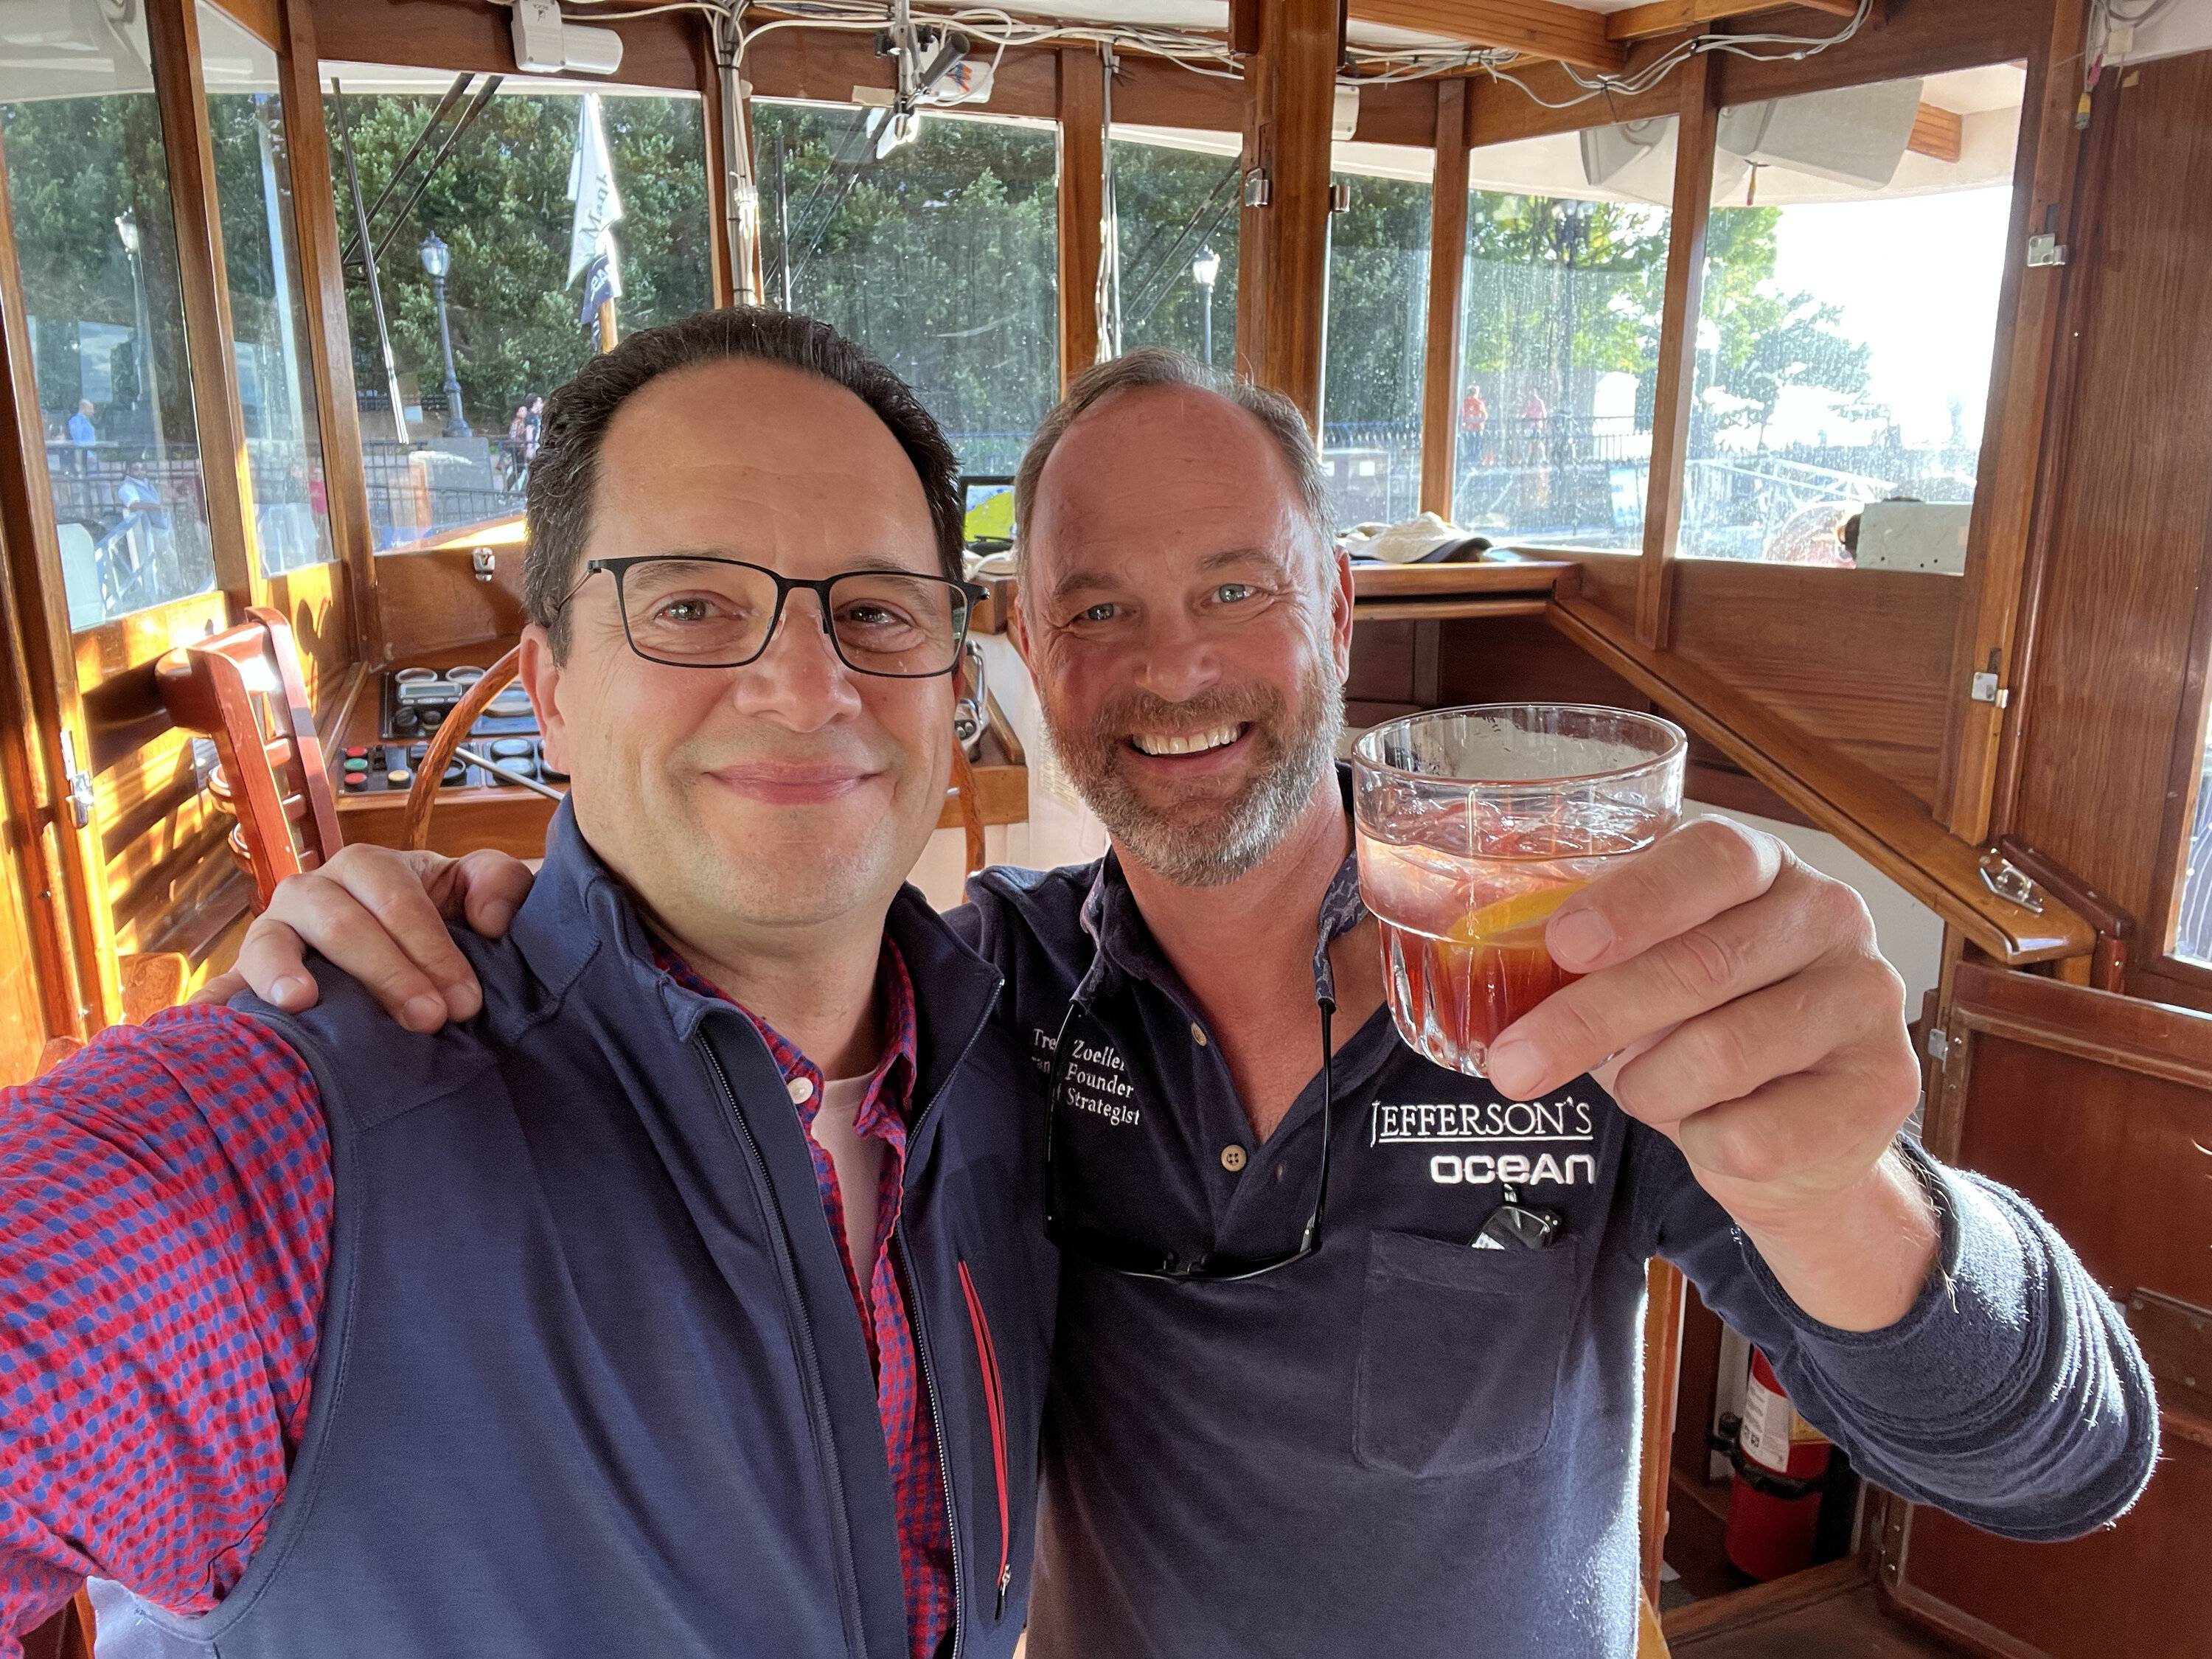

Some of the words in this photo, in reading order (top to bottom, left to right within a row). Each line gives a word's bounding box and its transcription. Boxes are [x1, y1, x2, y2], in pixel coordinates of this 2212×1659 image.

[1065, 1062, 1134, 1098] Founder
[1067, 1088, 1140, 1126] Strategist
[1371, 1096, 1593, 1147] JEFFERSON'S
